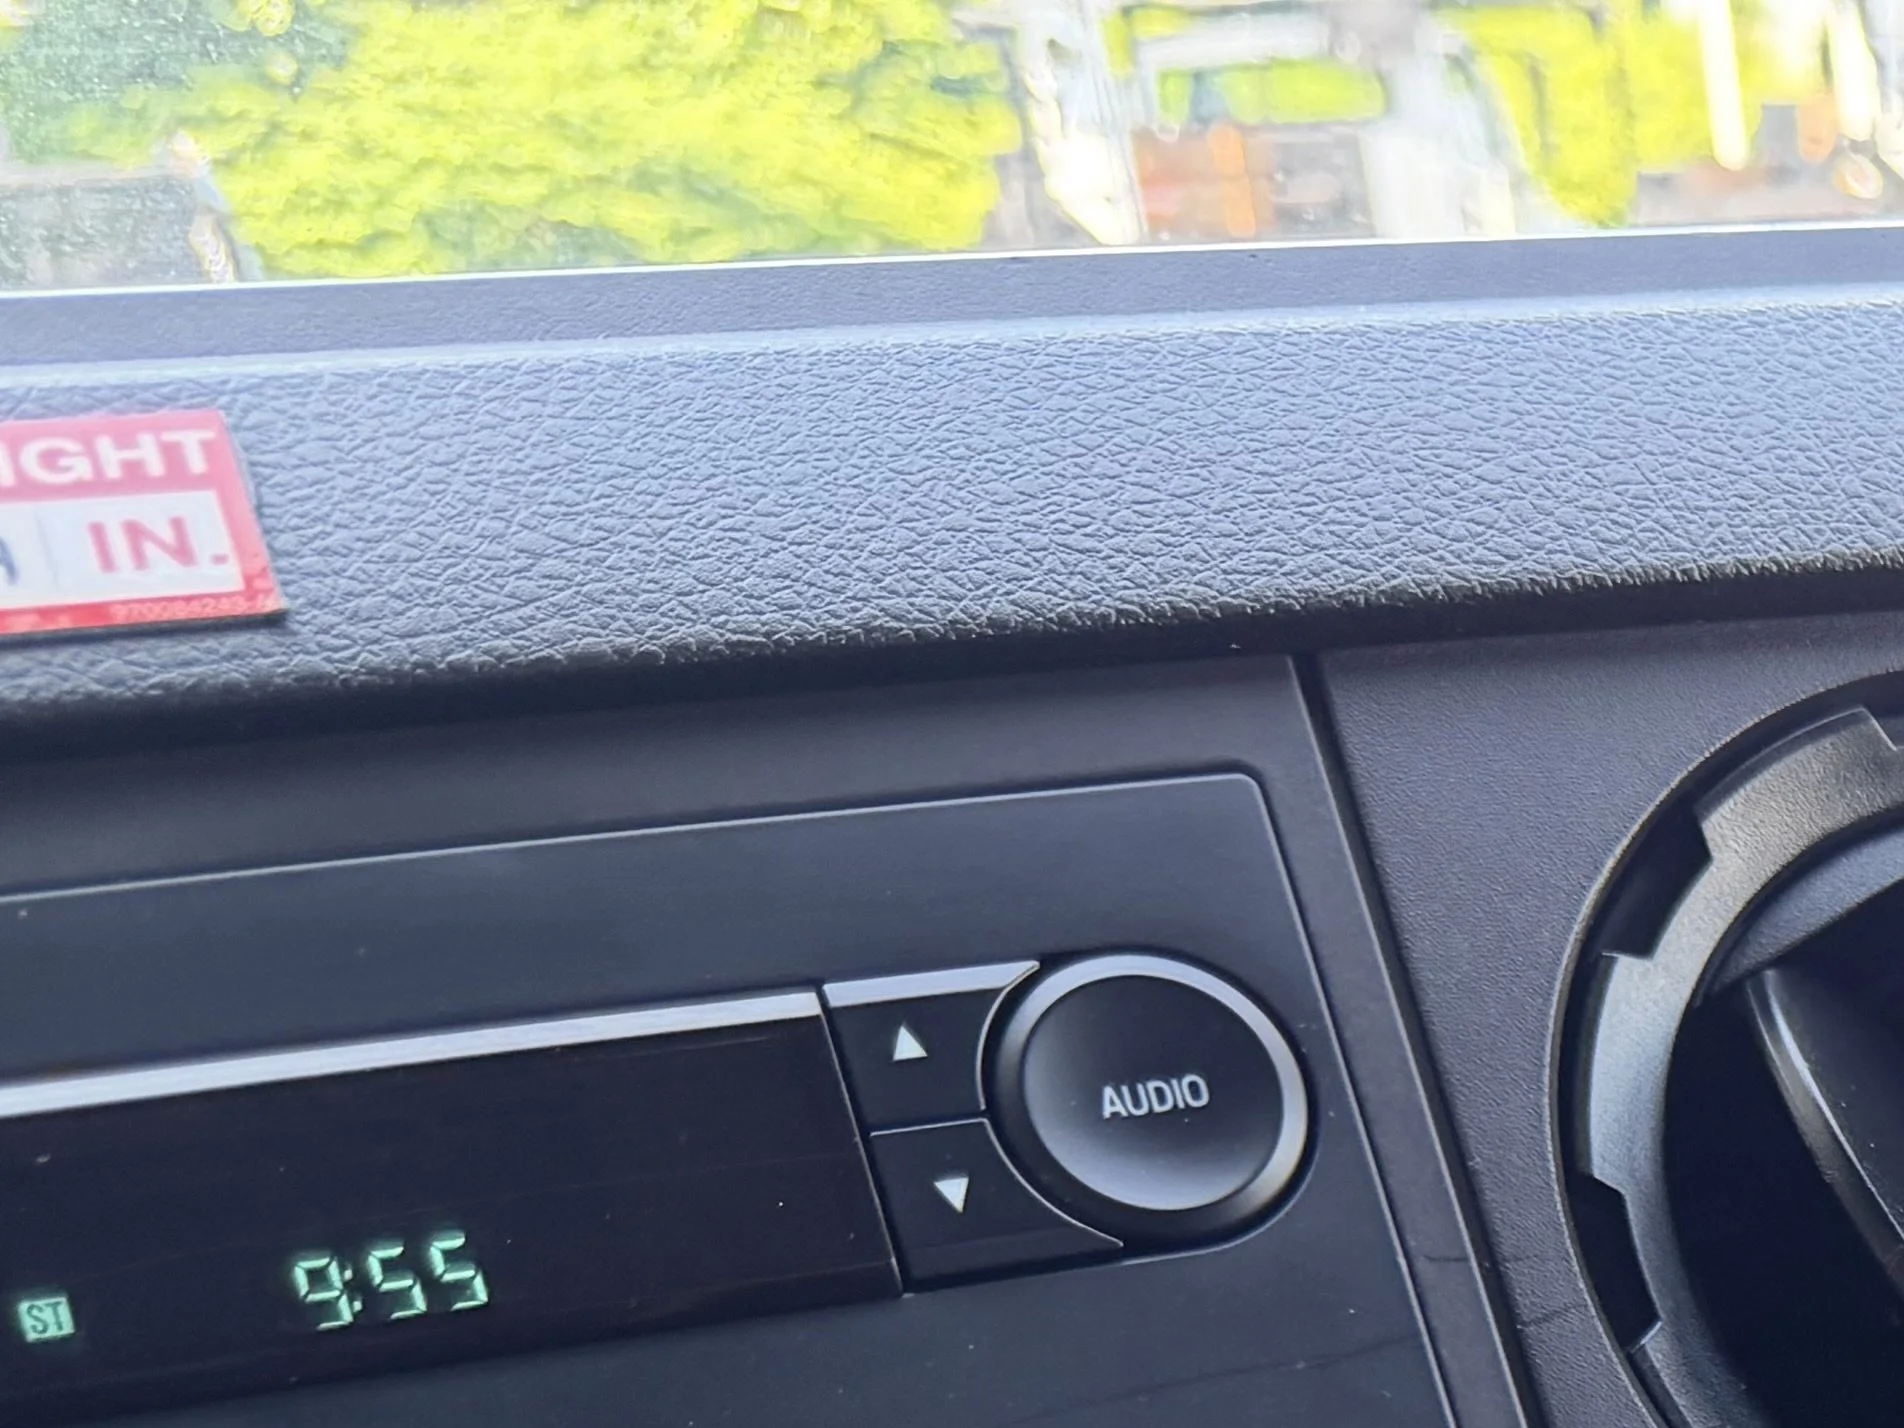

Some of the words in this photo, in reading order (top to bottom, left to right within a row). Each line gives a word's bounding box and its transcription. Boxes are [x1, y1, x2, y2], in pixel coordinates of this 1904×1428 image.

[88, 516, 229, 573] IN.
[1101, 1073, 1210, 1120] AUDIO
[26, 1301, 66, 1335] ST
[294, 1230, 489, 1332] 9:55
